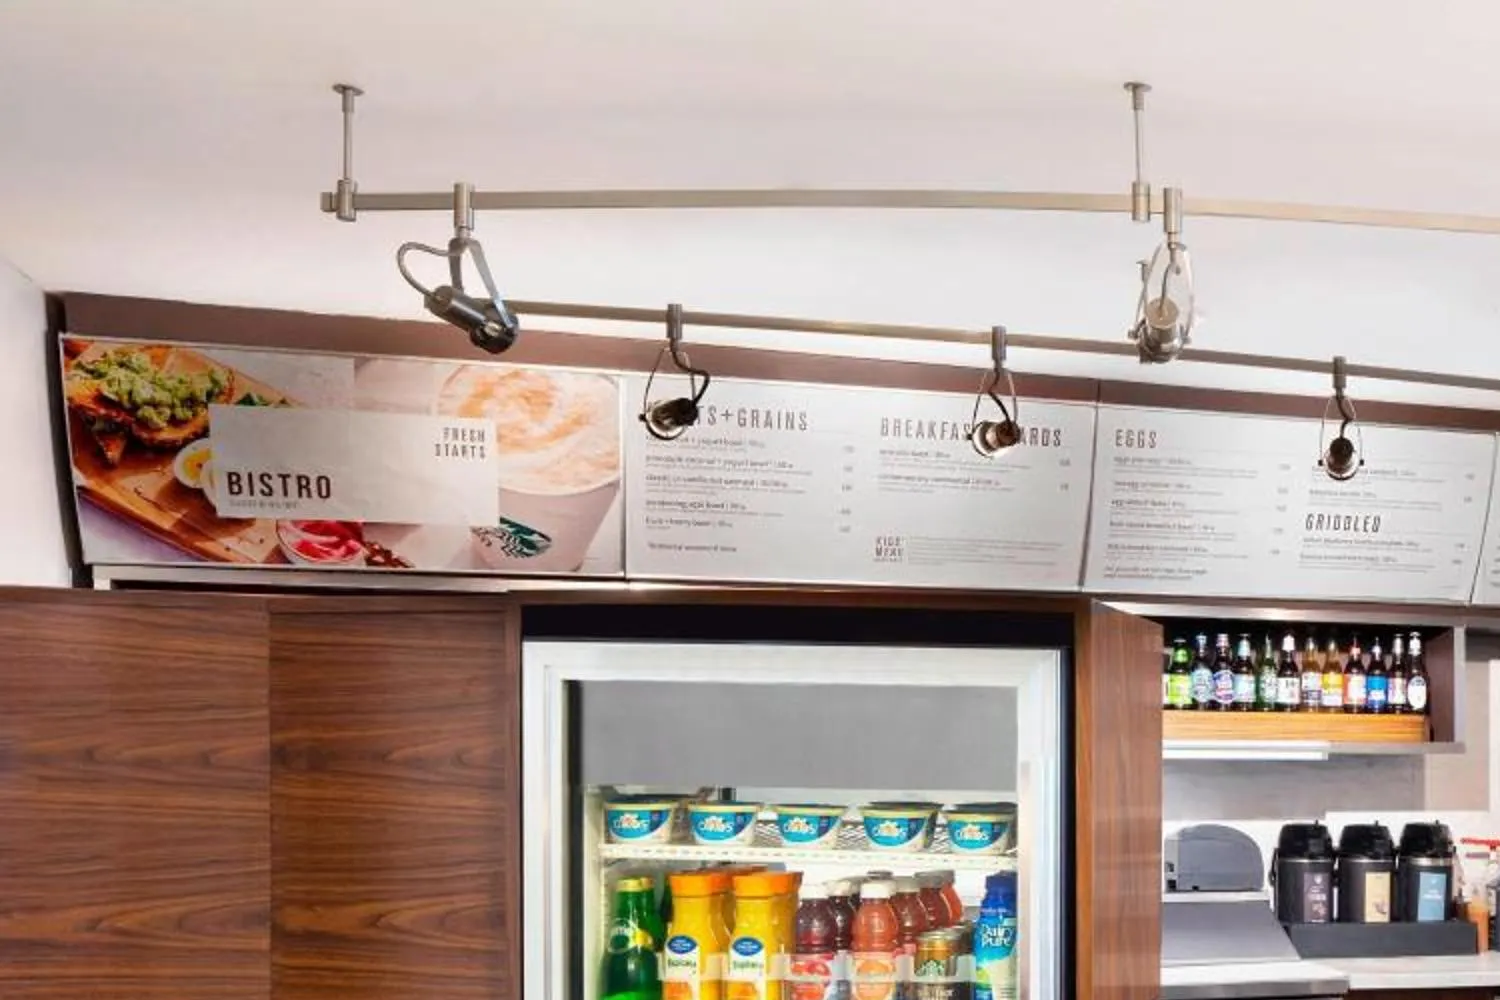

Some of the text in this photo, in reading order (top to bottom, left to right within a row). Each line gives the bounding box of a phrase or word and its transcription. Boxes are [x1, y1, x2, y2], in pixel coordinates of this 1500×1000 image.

[442, 426, 486, 443] FRESH
[880, 417, 1062, 447] BREAKFAS ARDS
[1115, 429, 1158, 449] EGGS
[434, 443, 487, 459] STARTS
[227, 471, 332, 499] BISTRO
[1304, 513, 1382, 533] GRIDDLED
